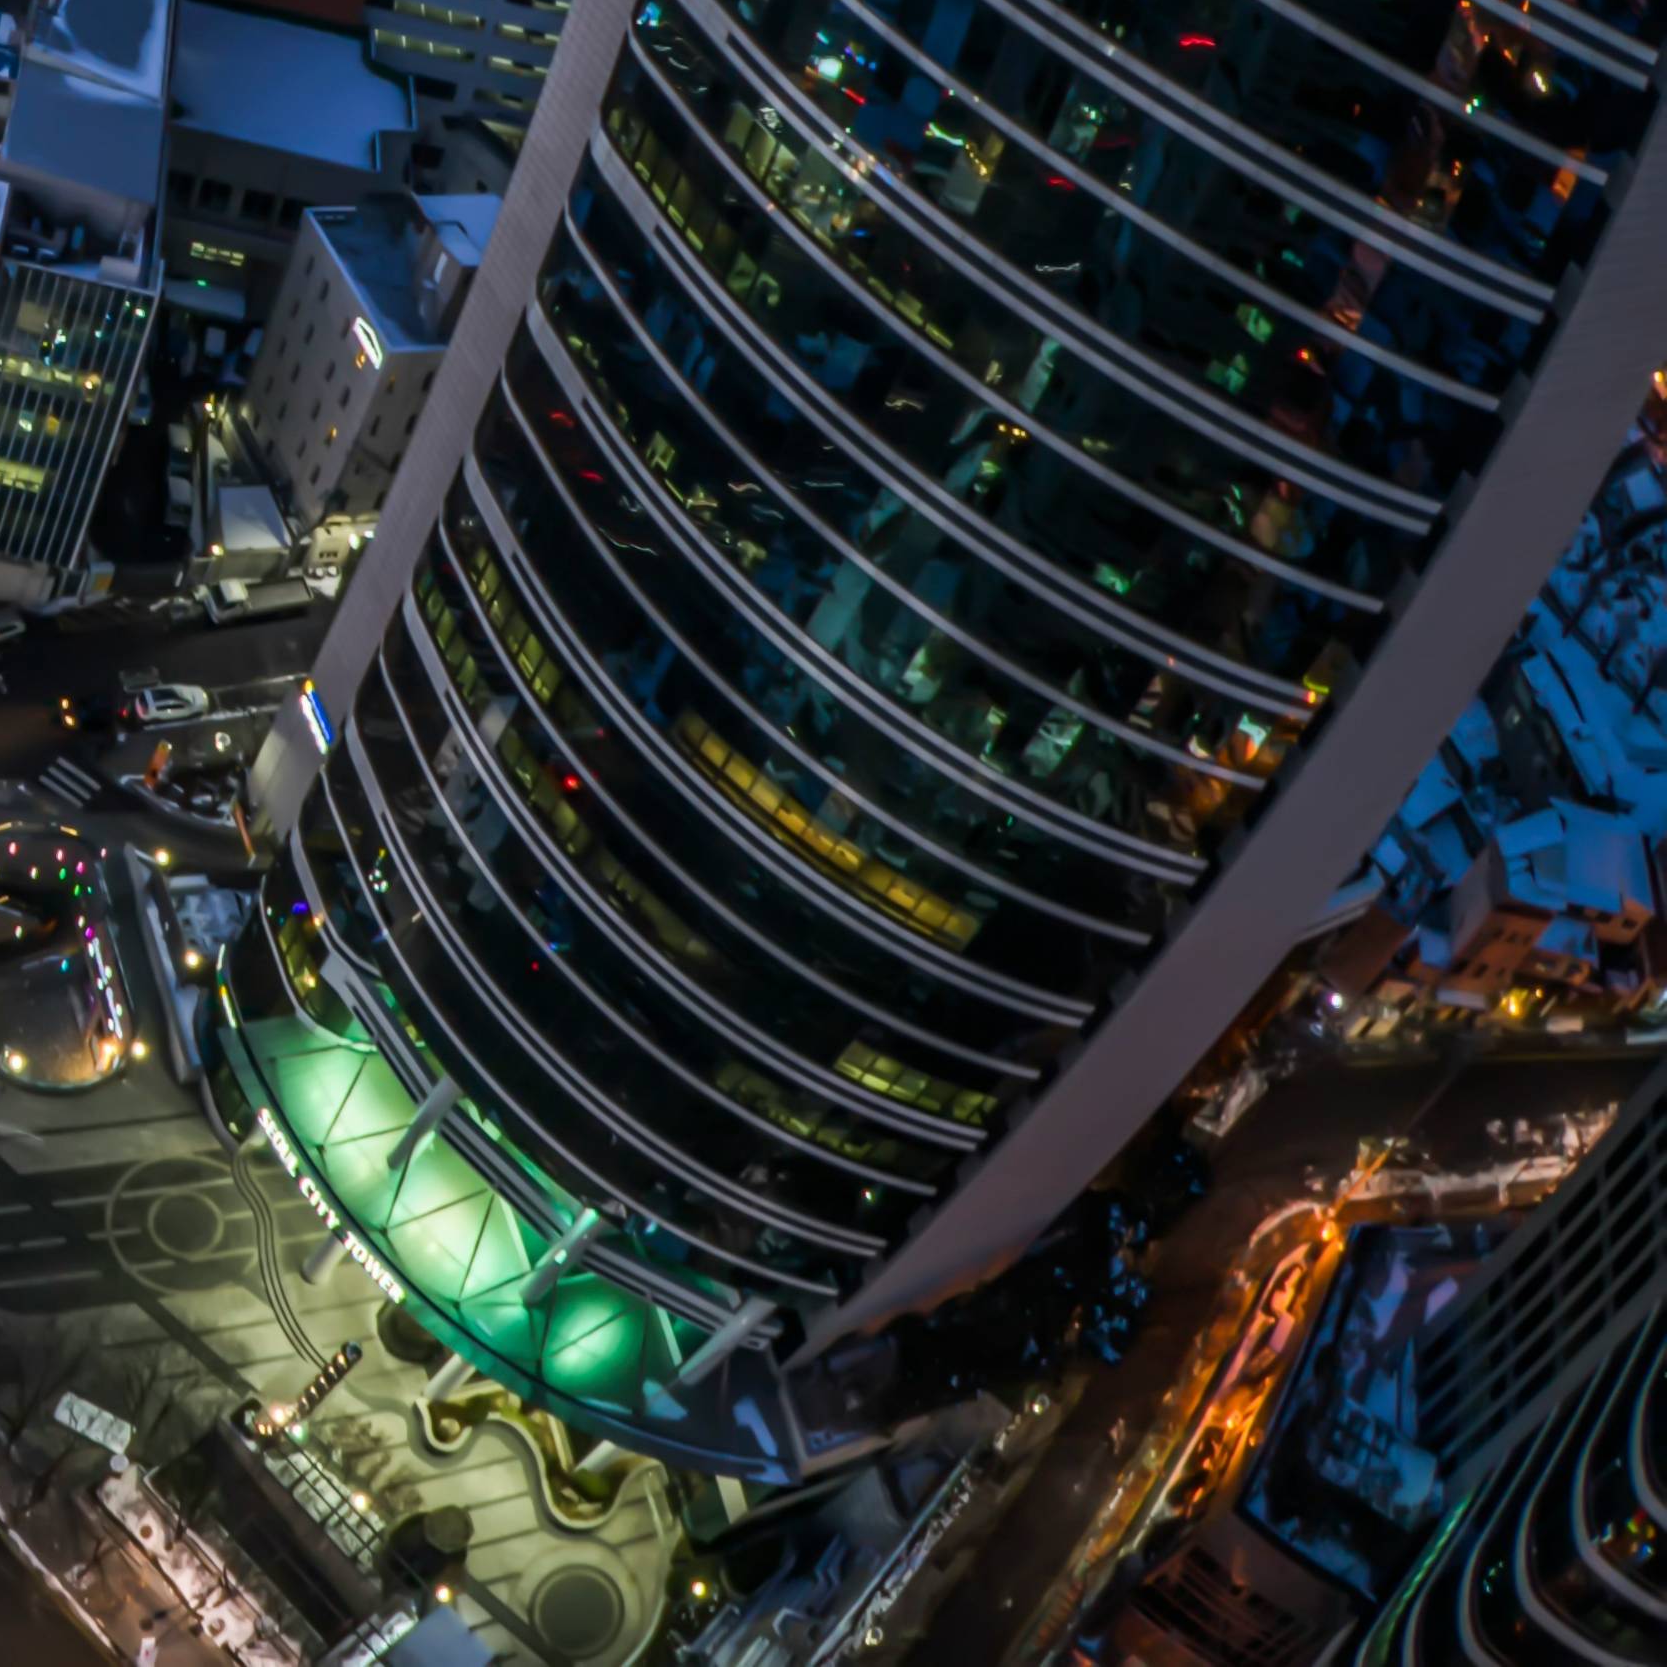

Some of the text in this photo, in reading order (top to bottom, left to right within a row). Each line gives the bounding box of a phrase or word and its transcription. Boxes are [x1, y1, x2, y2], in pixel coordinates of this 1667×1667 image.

[257, 1107, 406, 1305] SEOUL CITY TOWER
